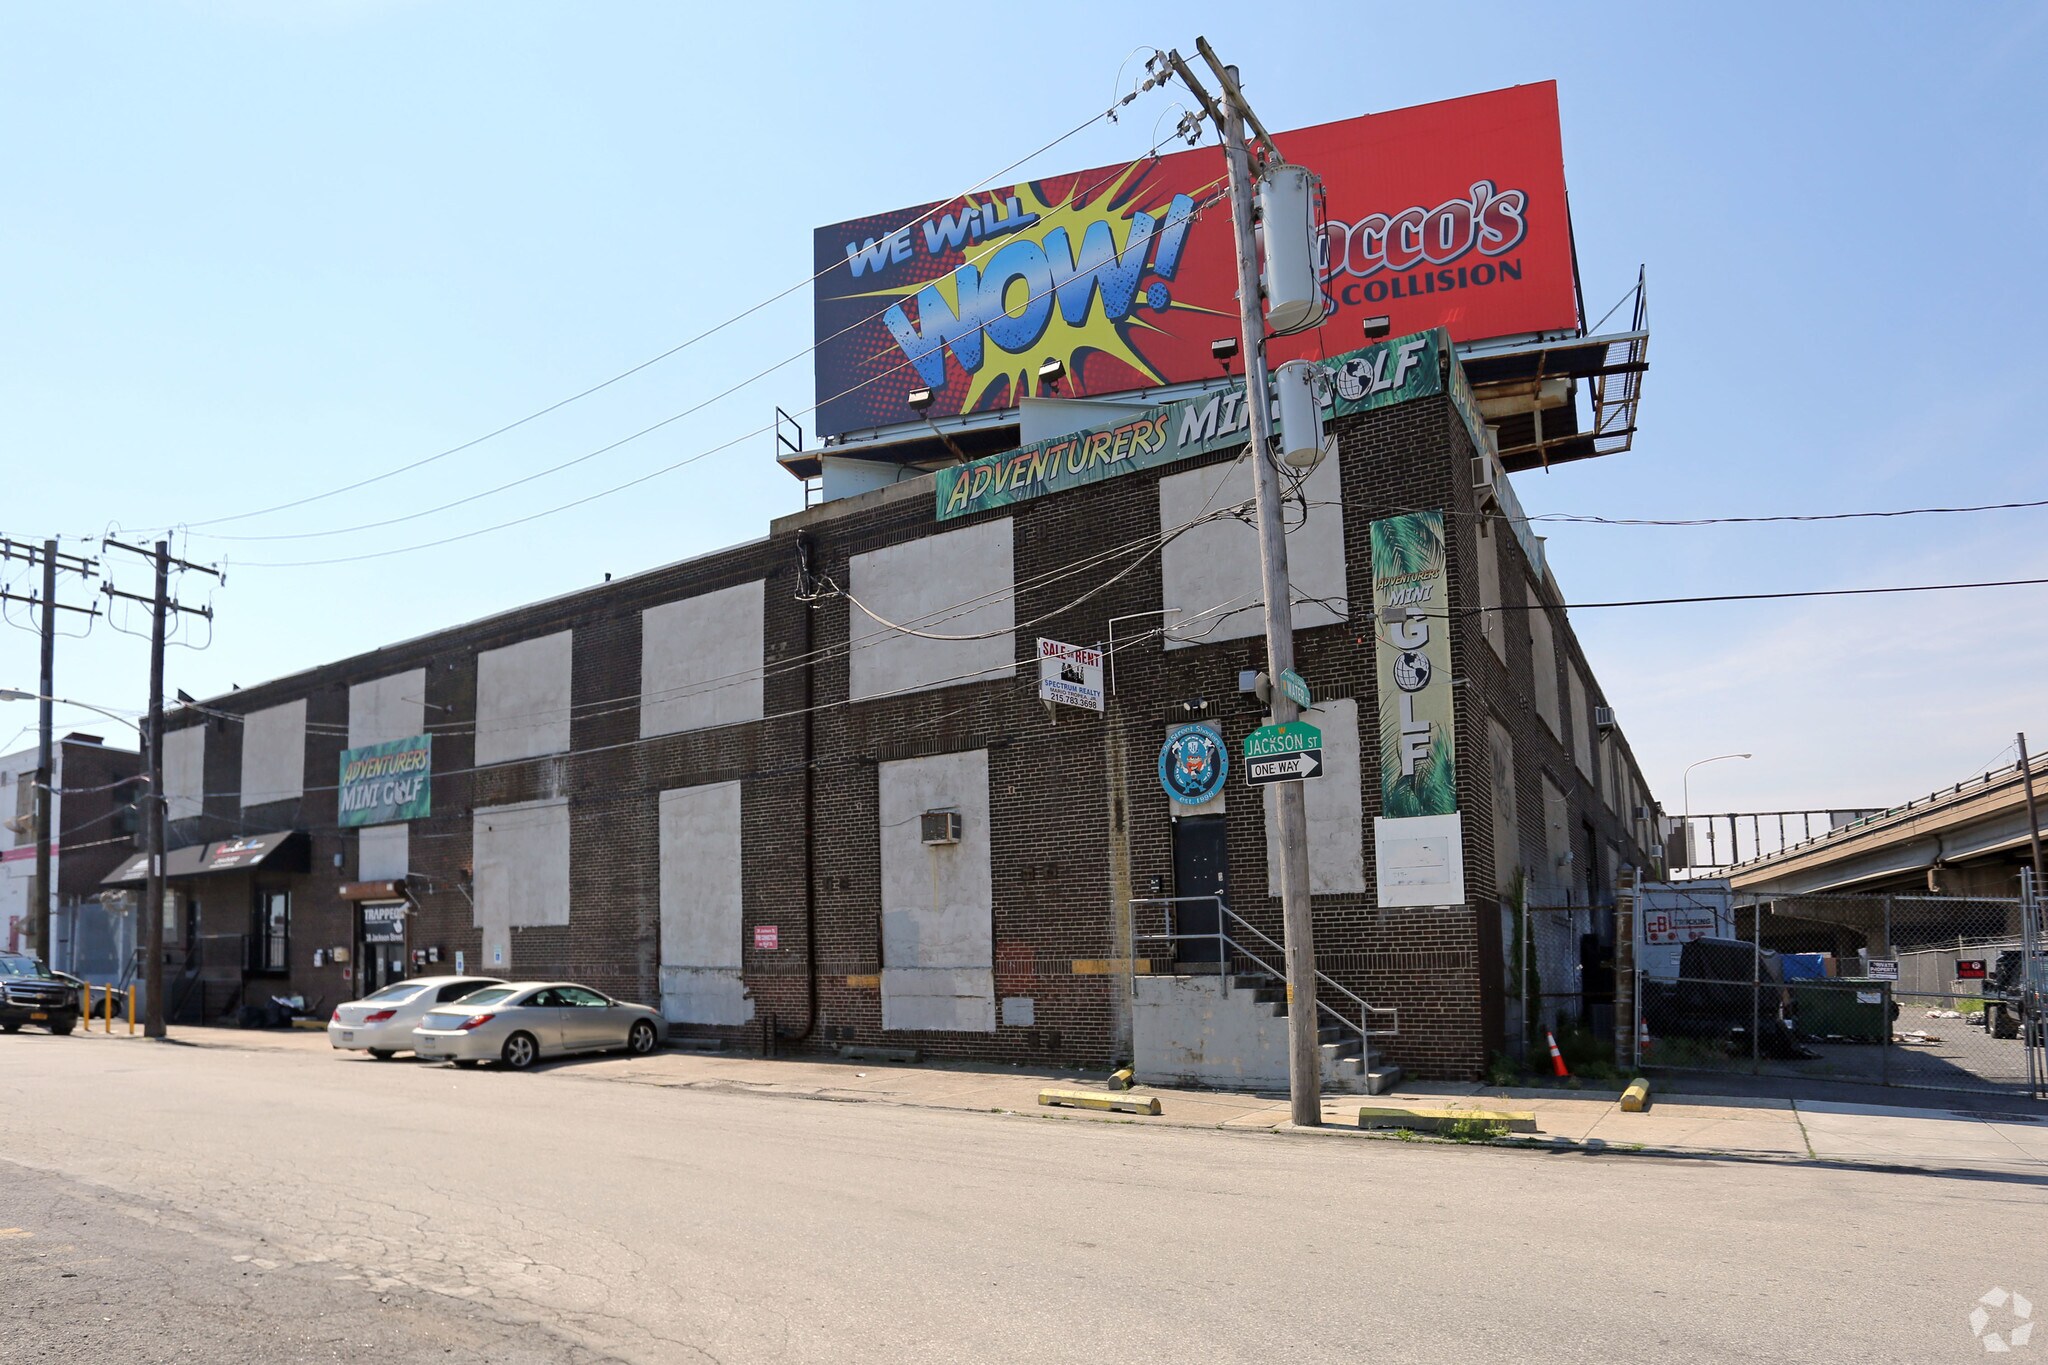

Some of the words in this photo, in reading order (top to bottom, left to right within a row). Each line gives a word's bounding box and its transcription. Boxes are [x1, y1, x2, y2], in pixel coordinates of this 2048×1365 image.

[844, 228, 914, 278] WE
[882, 193, 1195, 388] WOW!
[1341, 258, 1523, 306] COLLISION
[944, 413, 1170, 515] ADVENTURERS
[1177, 389, 1283, 448] MI
[1376, 568, 1440, 592] ADVENTURERS
[1389, 584, 1433, 608] MINI
[1043, 641, 1066, 660] SALE
[1075, 650, 1101, 667] RENT
[1045, 679, 1077, 692] SPECTRUM
[1079, 685, 1101, 697] REALTY
[1050, 692, 1097, 709] 215.783.3698
[1248, 733, 1303, 756] JACKSON
[1307, 736, 1318, 748] ST
[342, 749, 428, 787] ADVENTURERS
[1255, 763, 1275, 776] ONE
[1278, 760, 1300, 773] WAY
[341, 783, 380, 812] MINI
